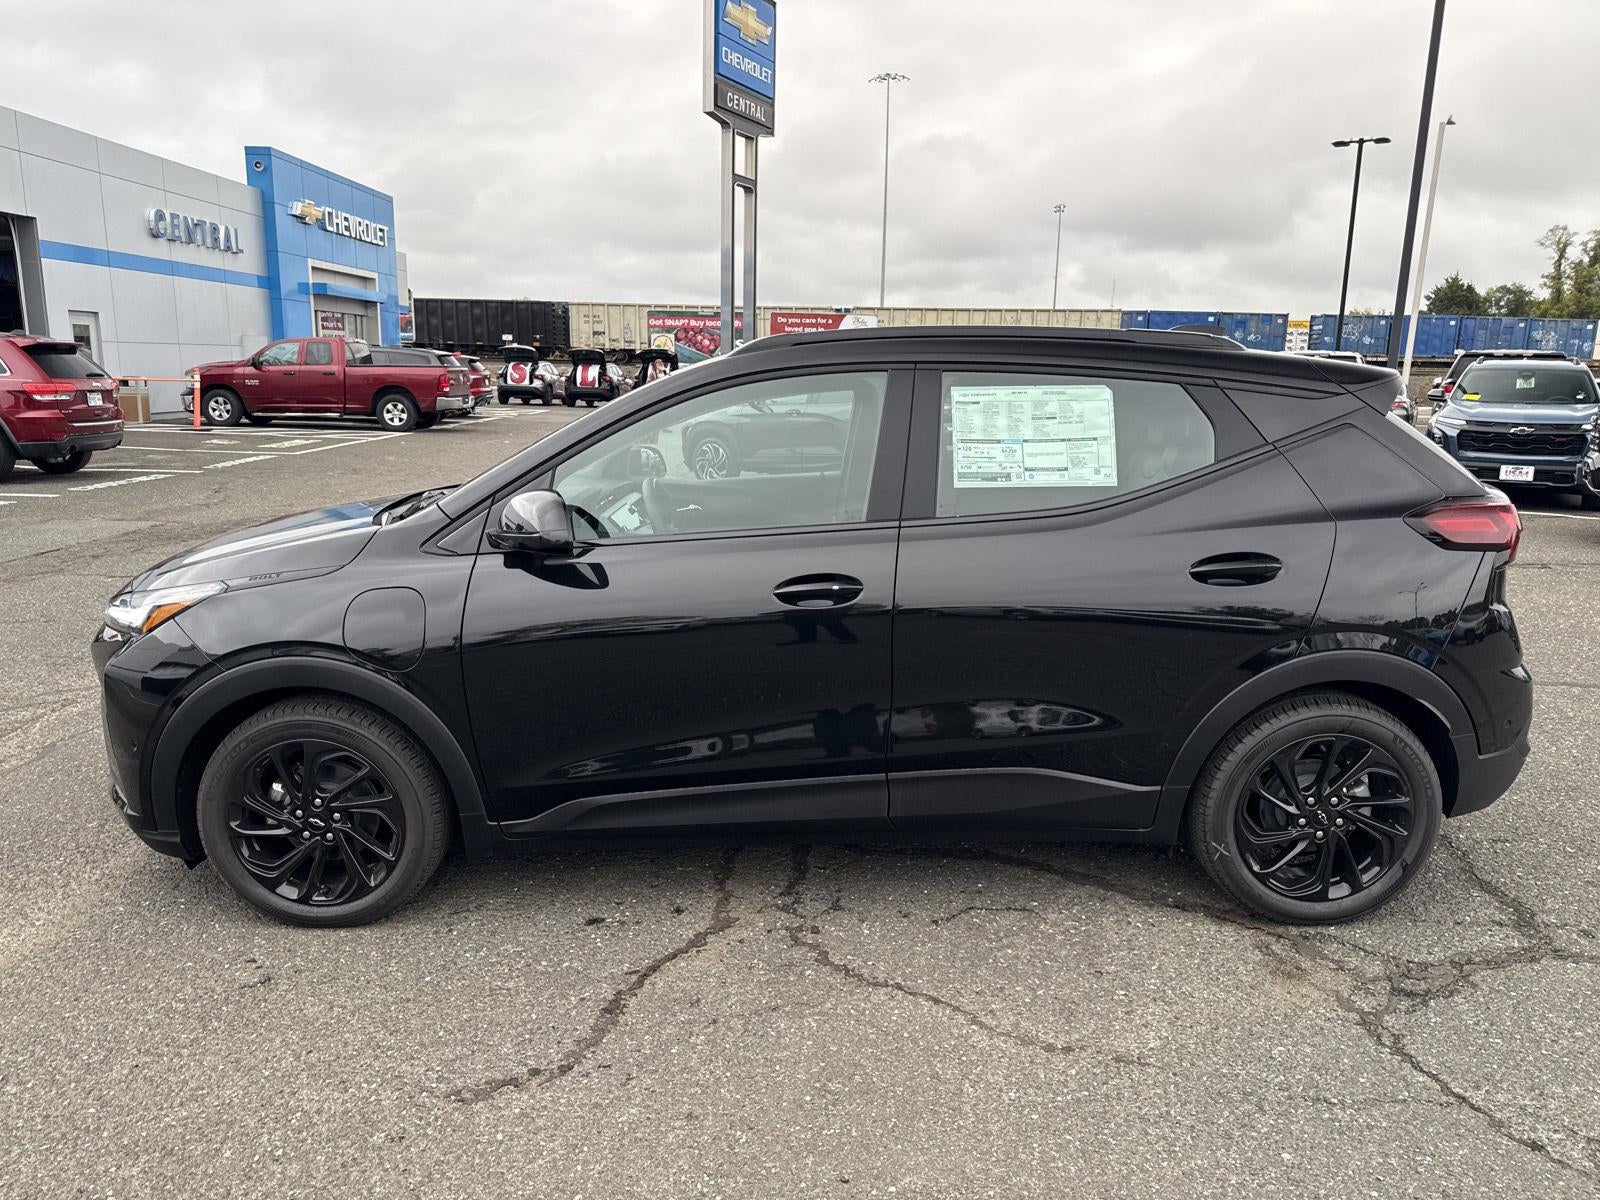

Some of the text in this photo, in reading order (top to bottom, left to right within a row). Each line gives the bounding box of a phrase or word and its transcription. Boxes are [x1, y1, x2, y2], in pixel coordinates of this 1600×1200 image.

[722, 47, 772, 84] CHEVROLET
[727, 92, 766, 122] CENTRAL
[146, 208, 244, 254] CENTRAL
[324, 207, 389, 247] CHEVROLET
[664, 319, 688, 327] SNAP?
[689, 319, 704, 329] Buy
[509, 362, 528, 384] S
[579, 363, 596, 387] L
